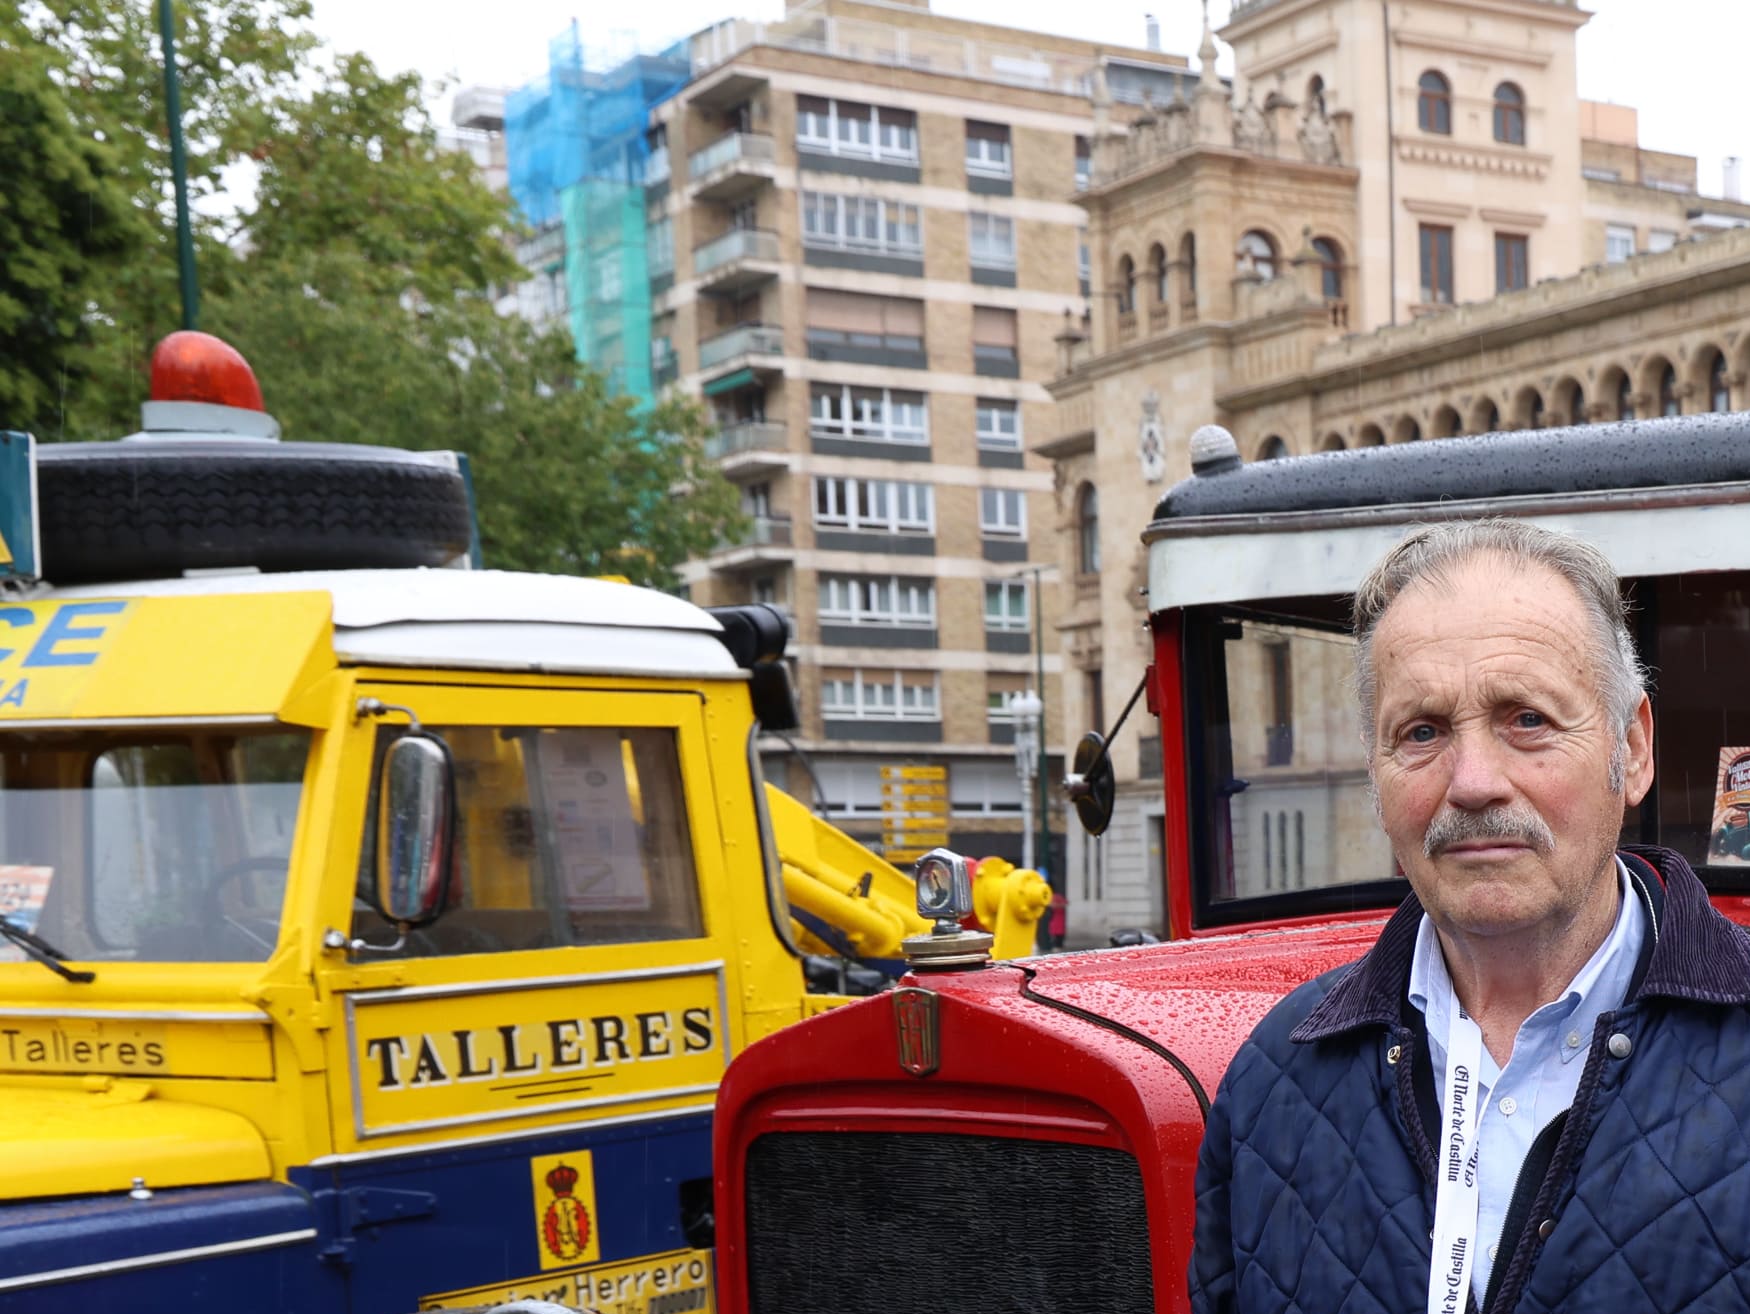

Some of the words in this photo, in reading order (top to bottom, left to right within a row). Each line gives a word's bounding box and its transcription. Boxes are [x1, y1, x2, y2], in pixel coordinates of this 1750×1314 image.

[1, 1028, 165, 1067] Talleres
[367, 1007, 716, 1091] TALLERES
[1454, 1064, 1470, 1083] El
[1452, 1083, 1470, 1118] Norte
[1451, 1117, 1465, 1132] de
[1447, 1132, 1465, 1183] Castilla
[1446, 1236, 1468, 1288] Castilla
[574, 1259, 706, 1306] Herrero
[1443, 1288, 1459, 1303] de
